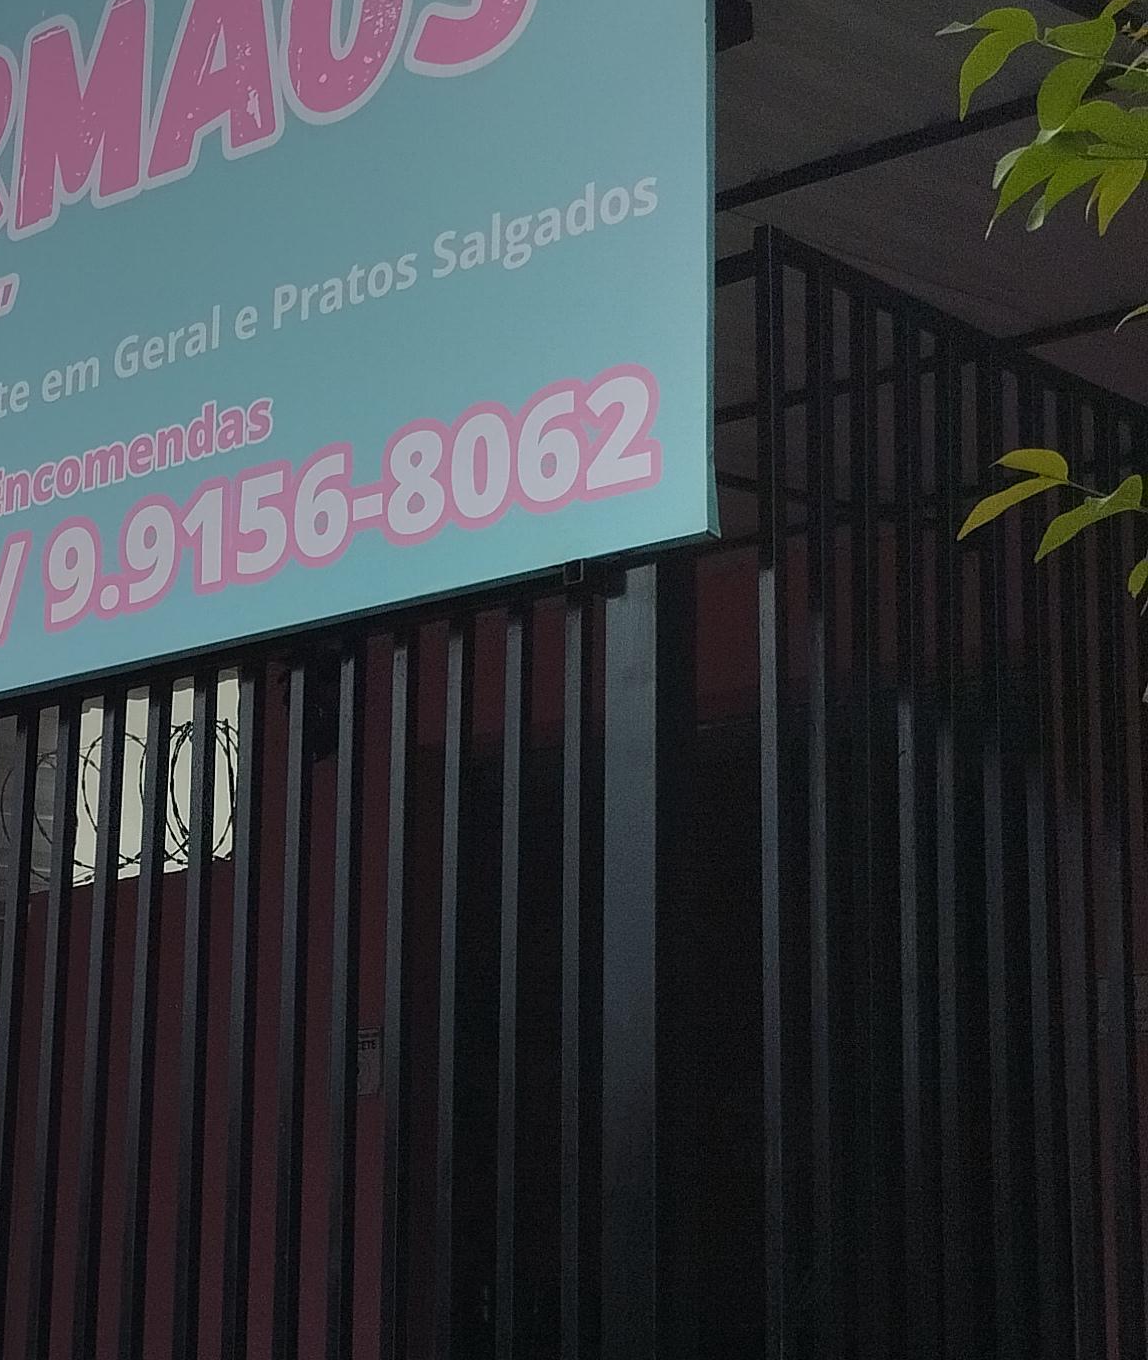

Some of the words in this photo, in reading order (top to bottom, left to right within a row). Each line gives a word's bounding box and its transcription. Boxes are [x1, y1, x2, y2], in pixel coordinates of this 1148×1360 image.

[41, 354, 100, 403] em
[114, 305, 220, 379] Geral
[234, 307, 258, 340] e
[274, 251, 418, 329] Pratos
[432, 176, 658, 278] Salgados
[45, 369, 658, 629] 9.9156-8062
